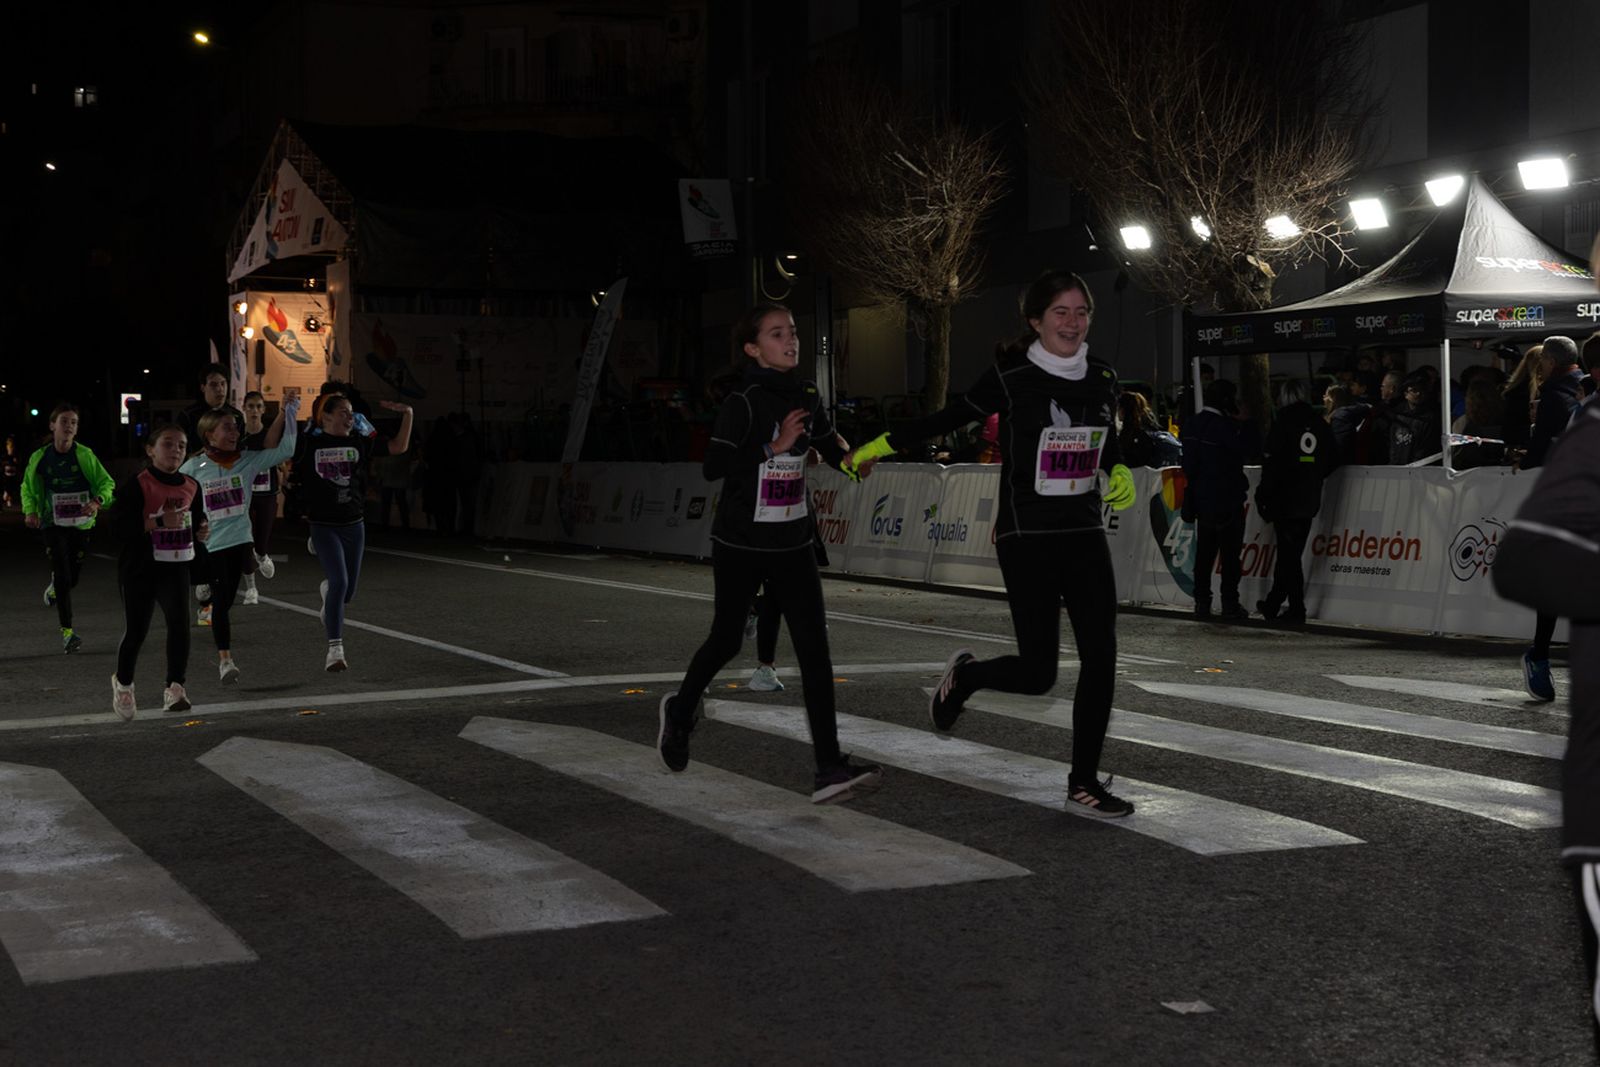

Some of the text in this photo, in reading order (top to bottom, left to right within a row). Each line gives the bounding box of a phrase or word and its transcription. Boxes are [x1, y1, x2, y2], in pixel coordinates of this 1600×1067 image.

[1456, 305, 1545, 326] superscreen
[277, 334, 297, 354] 43
[813, 488, 839, 515] SAN
[815, 511, 851, 545] NTÓN
[928, 519, 968, 548] aqualia
[1163, 522, 1194, 568] 43
[1311, 528, 1421, 561] calderón
[1330, 565, 1392, 577] obras maestras
